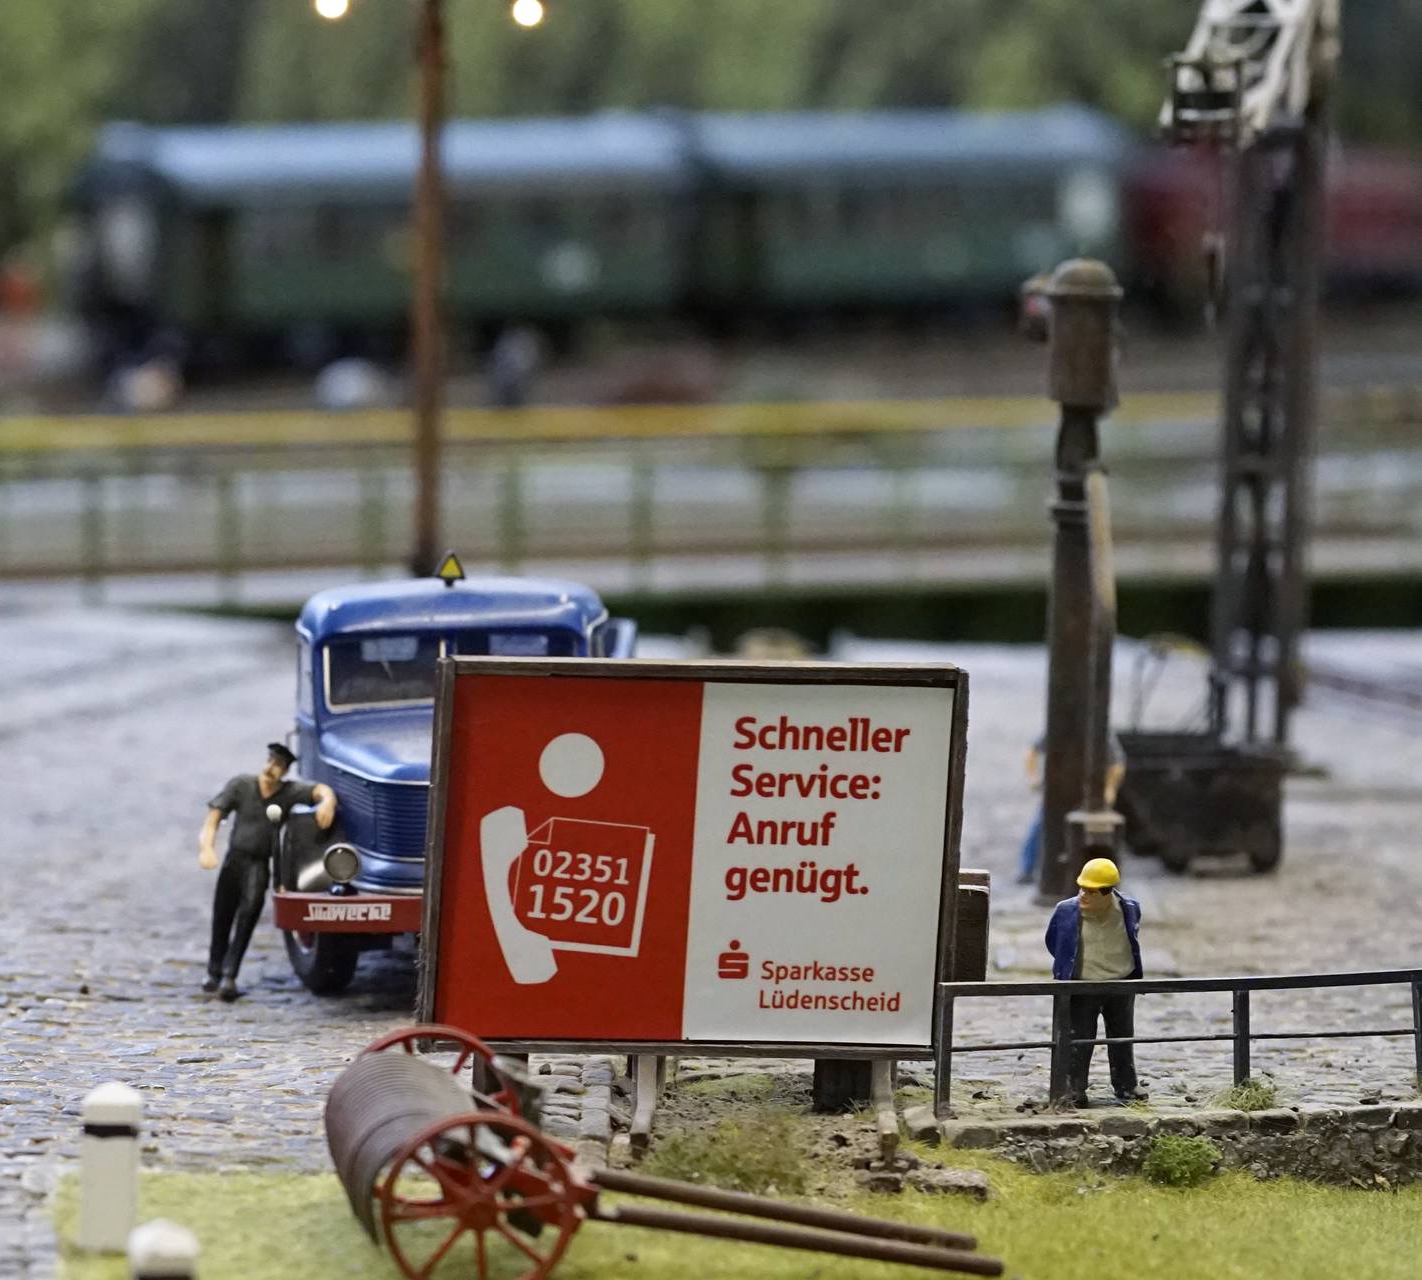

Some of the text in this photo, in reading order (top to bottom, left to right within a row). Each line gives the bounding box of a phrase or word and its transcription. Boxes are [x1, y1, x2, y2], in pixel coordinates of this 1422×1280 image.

[733, 716, 911, 752] Schneller
[730, 763, 882, 800] Service:
[726, 811, 837, 846] Anruf
[533, 849, 630, 885] 02351
[724, 861, 869, 903] genügt.
[527, 884, 626, 926] 1520
[761, 960, 874, 984] Sparkasse
[759, 989, 901, 1012] Lüdenscheid
